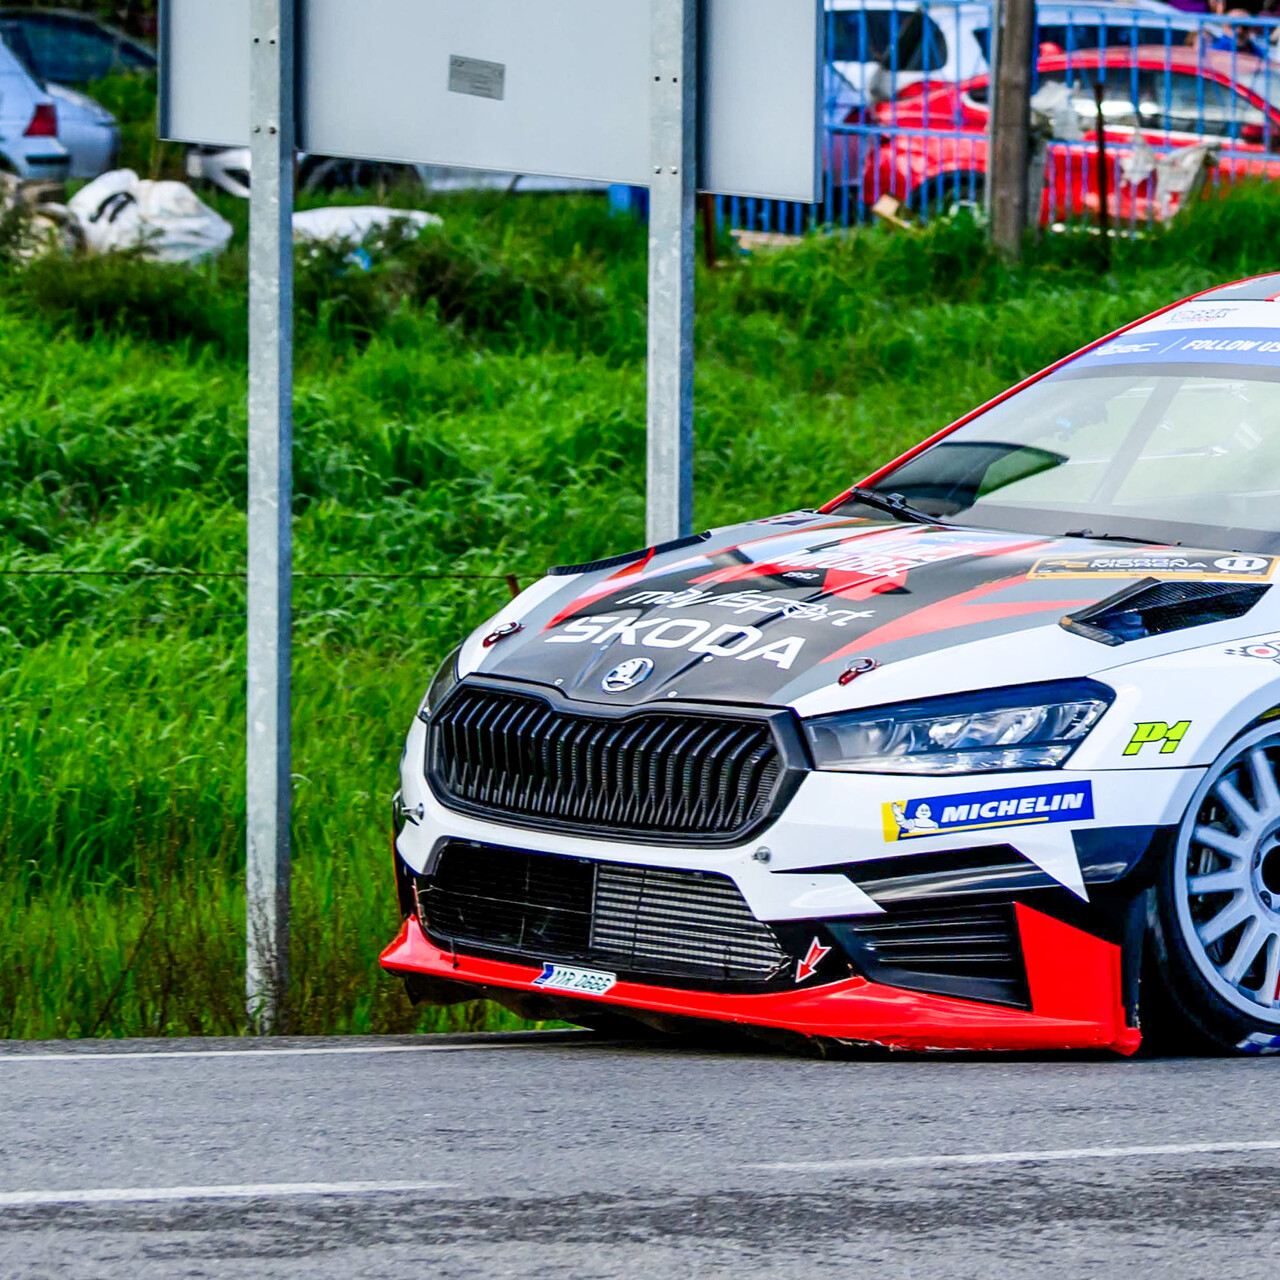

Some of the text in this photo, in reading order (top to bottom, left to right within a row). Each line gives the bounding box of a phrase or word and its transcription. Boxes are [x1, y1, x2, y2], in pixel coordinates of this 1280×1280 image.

[1180, 339, 1261, 354] FOLLOW
[1226, 558, 1255, 568] 11
[1121, 719, 1193, 756] P1
[940, 792, 1085, 824] MICHELIN
